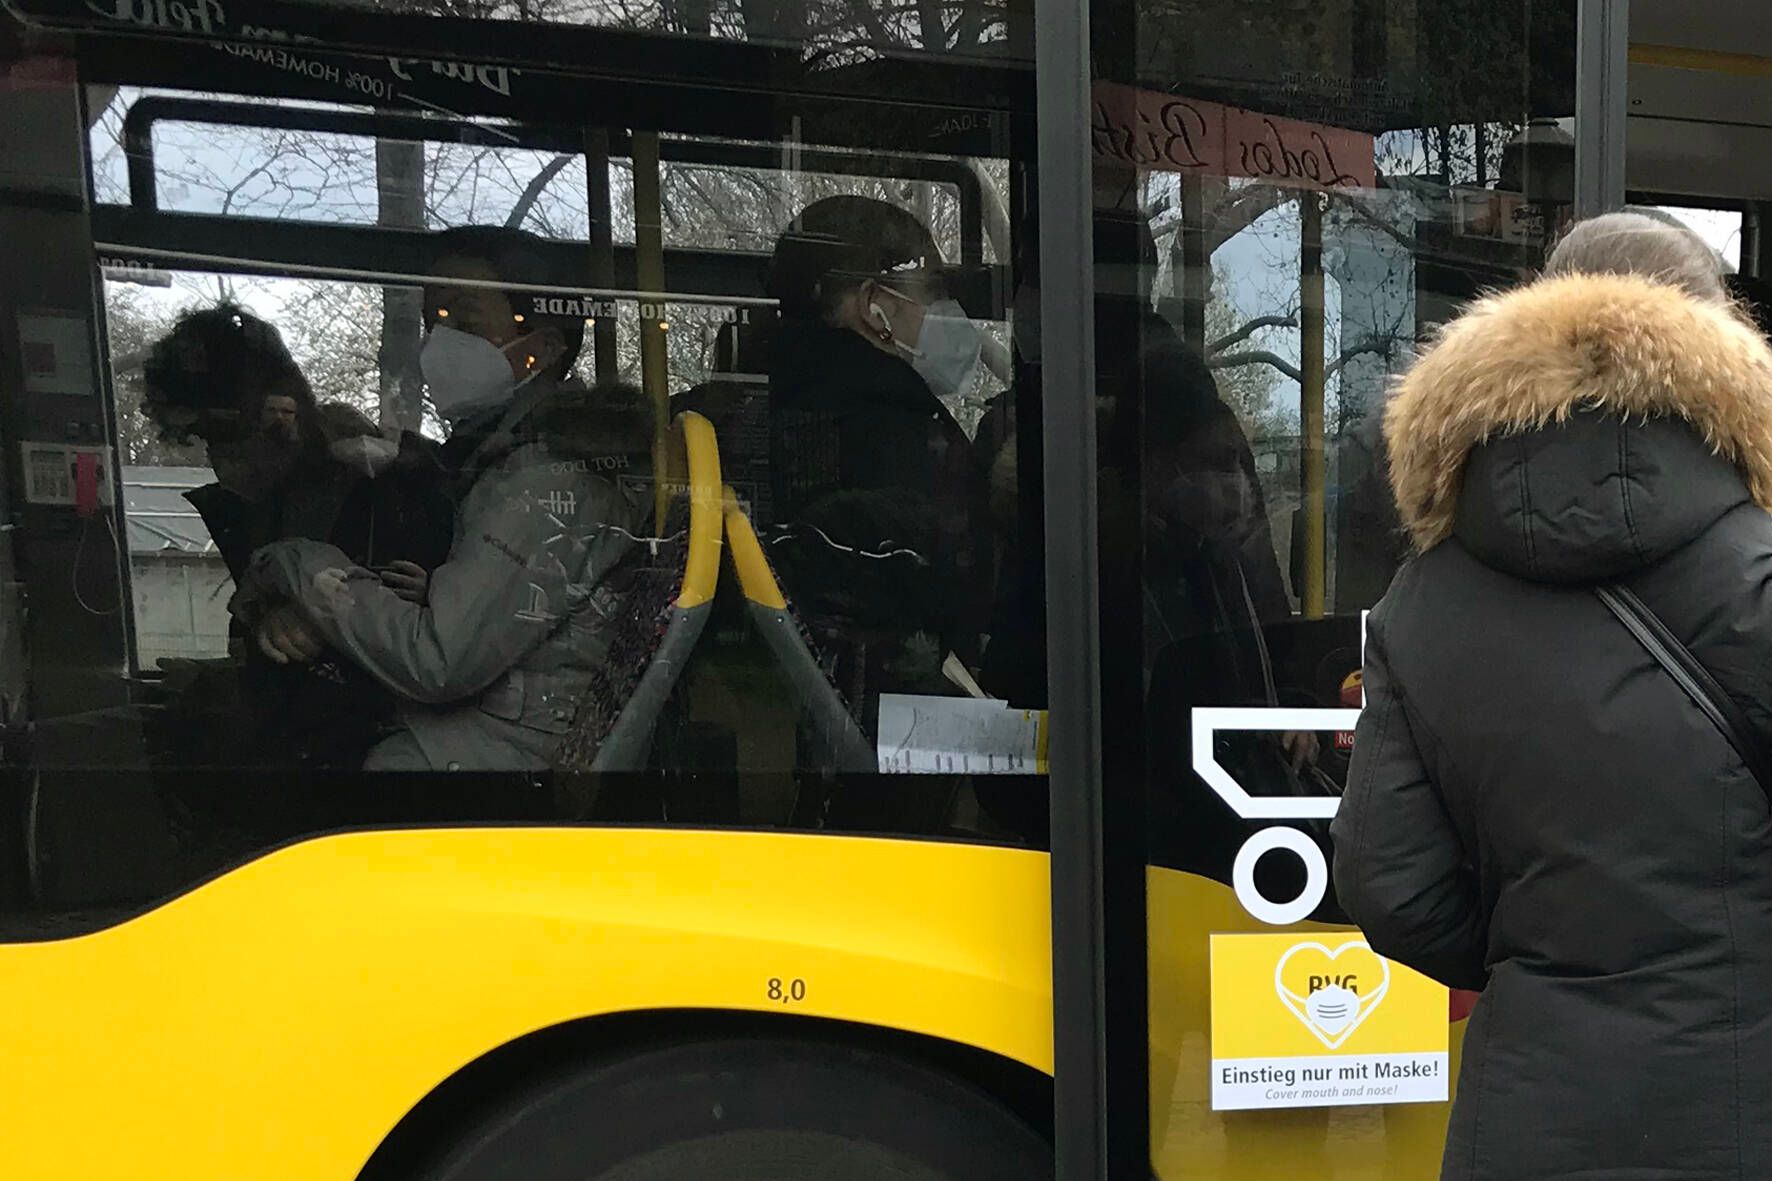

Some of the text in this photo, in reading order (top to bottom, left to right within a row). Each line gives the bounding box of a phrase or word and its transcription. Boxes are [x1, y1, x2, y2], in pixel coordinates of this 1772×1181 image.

[1338, 732, 1356, 745] No
[767, 978, 807, 1005] 8,0
[1221, 1060, 1439, 1086] Einstieg nur mit Maske!
[1265, 1083, 1399, 1100] Cover mouth and nose!
